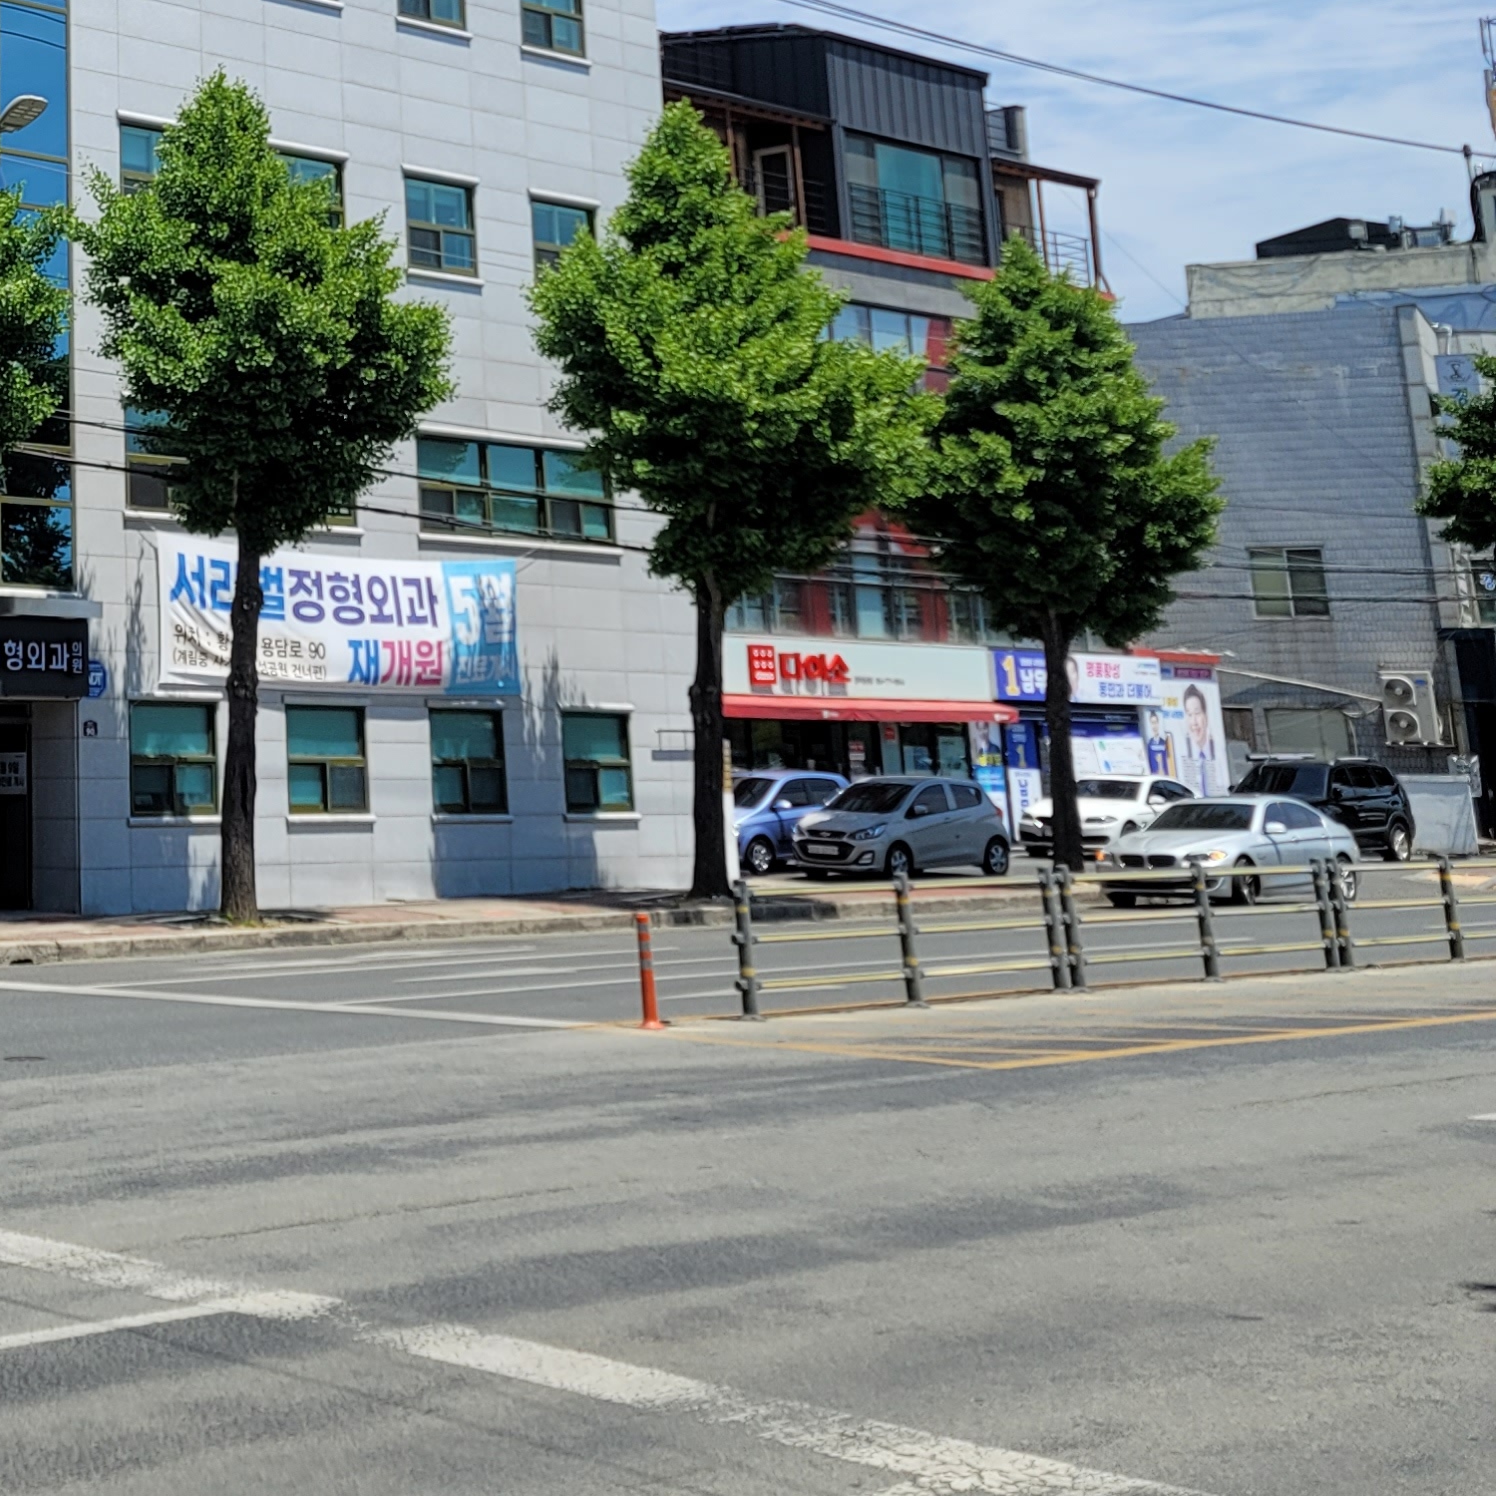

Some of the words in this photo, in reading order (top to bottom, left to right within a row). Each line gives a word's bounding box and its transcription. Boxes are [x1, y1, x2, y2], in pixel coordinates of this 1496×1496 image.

[448, 573, 514, 646] 5월
[71, 641, 84, 674] 의원
[261, 636, 303, 660] 용담로
[308, 642, 327, 660] 90
[348, 639, 442, 686] 재개원
[778, 651, 852, 685] 다이소
